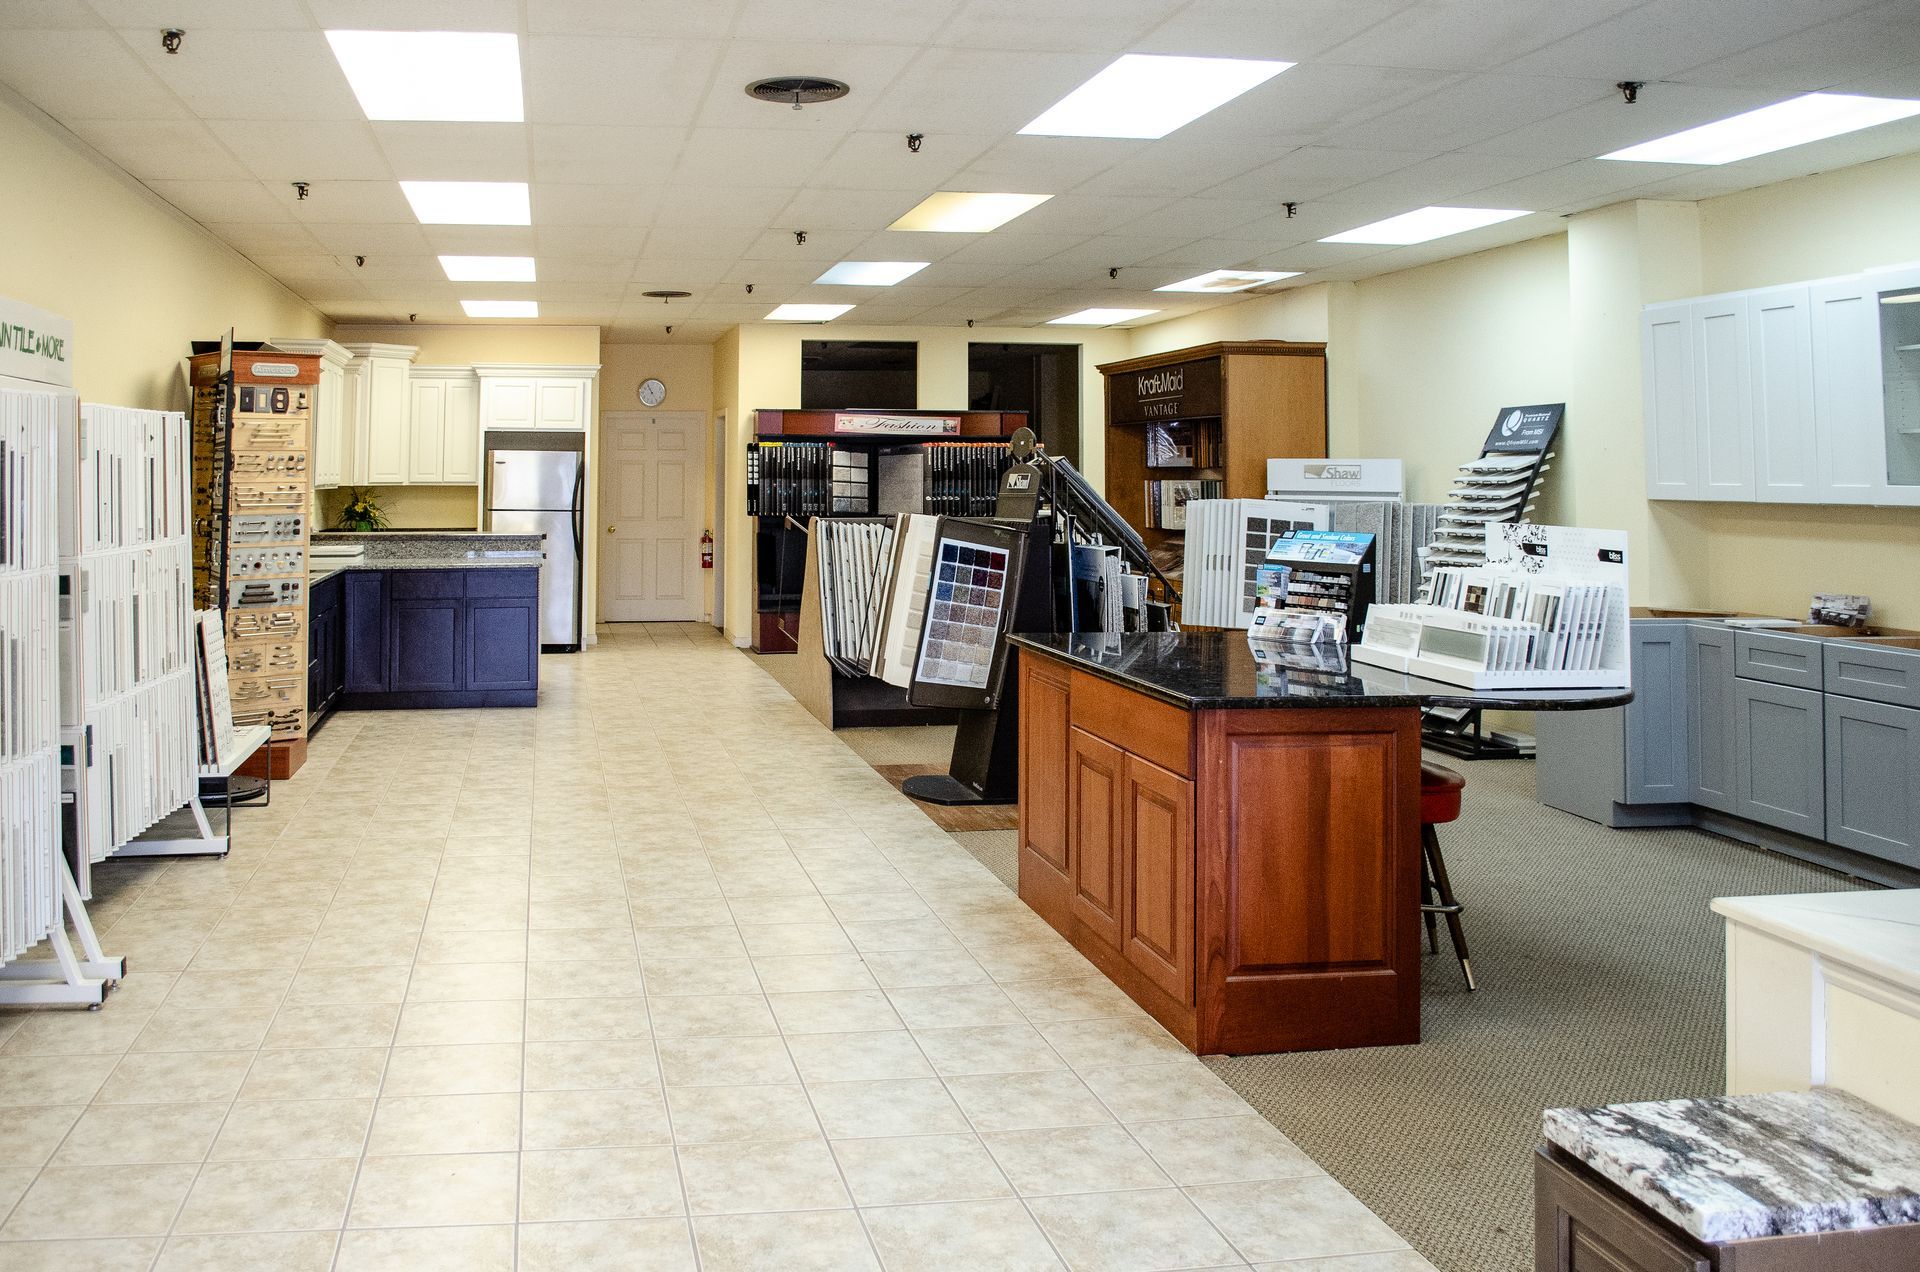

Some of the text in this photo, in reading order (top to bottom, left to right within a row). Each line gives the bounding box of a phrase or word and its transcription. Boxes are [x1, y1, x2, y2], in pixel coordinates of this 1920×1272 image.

[13, 325, 35, 355] TILE
[42, 334, 65, 362] MORE
[1138, 368, 1183, 396] KraftMaid
[1144, 402, 1178, 416] VANTAGE
[863, 417, 938, 431] Fashion
[1326, 466, 1360, 479] Shaw
